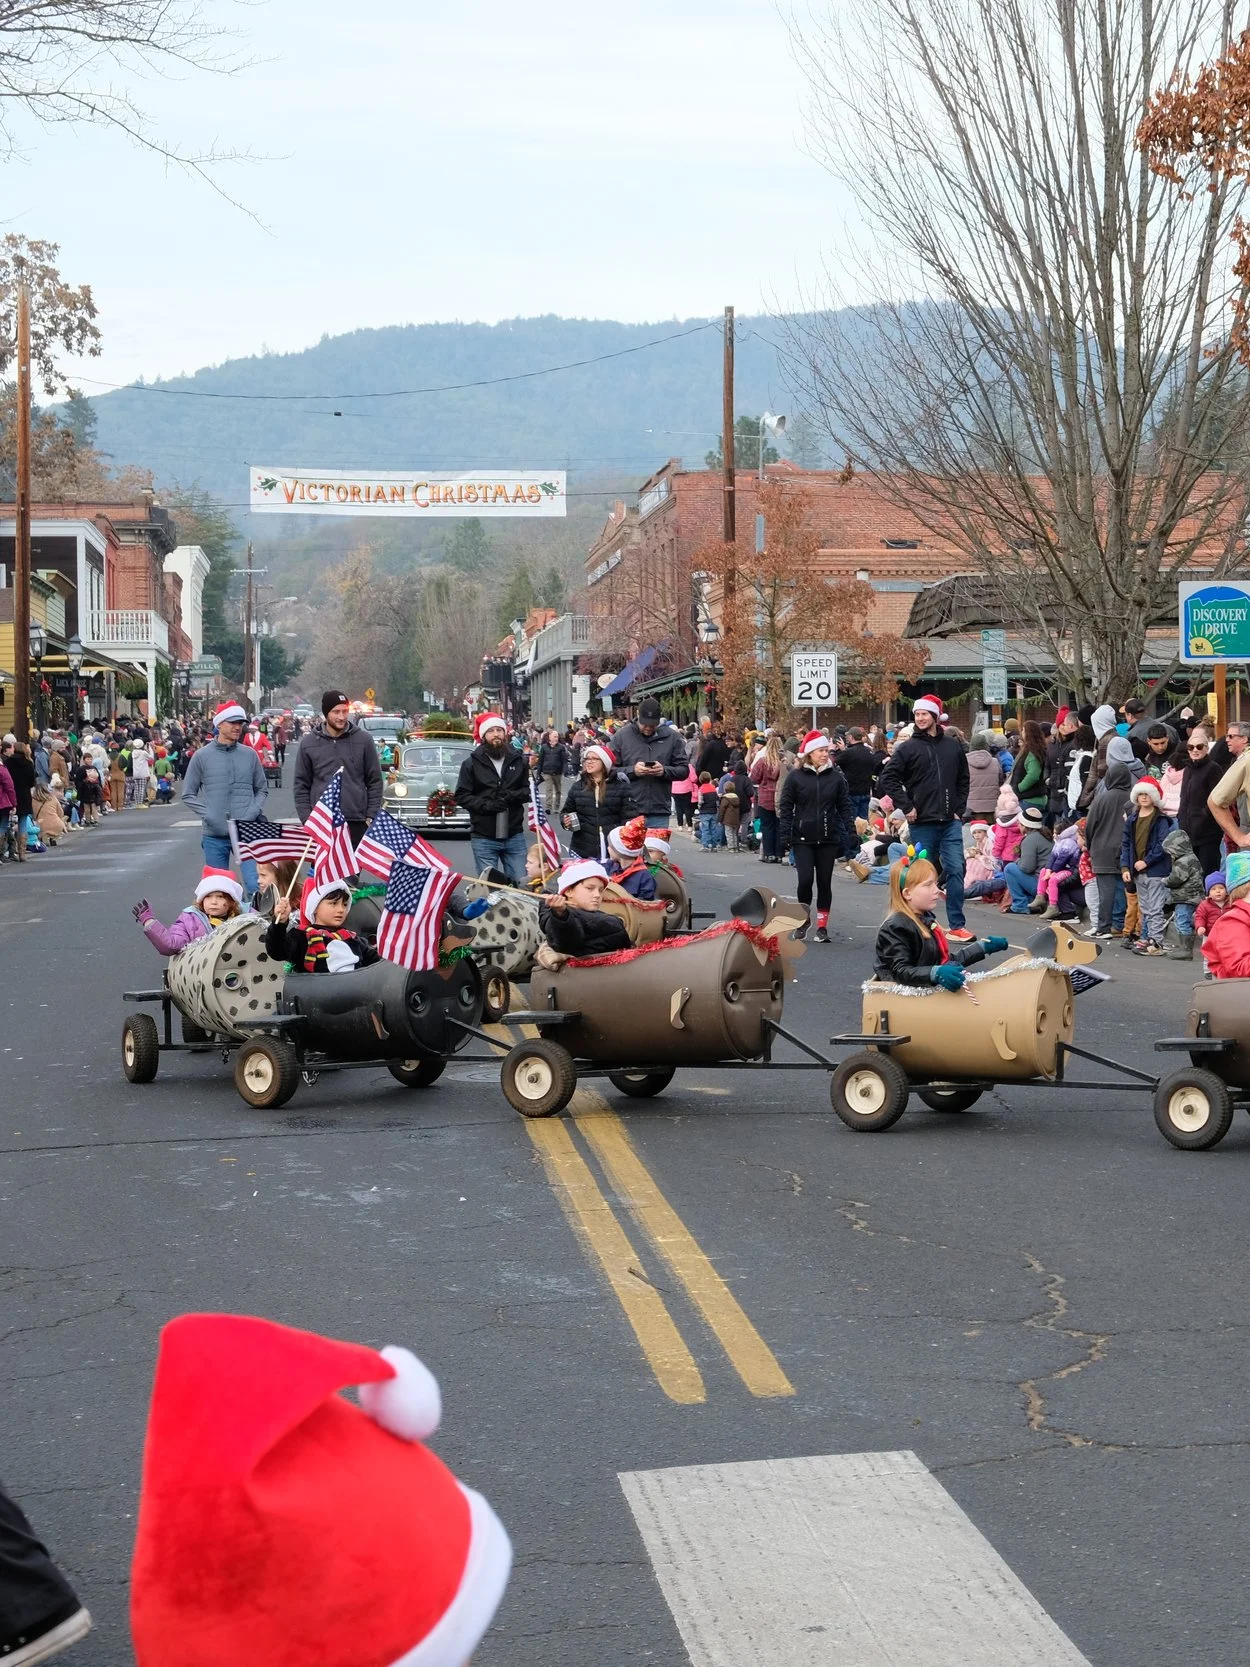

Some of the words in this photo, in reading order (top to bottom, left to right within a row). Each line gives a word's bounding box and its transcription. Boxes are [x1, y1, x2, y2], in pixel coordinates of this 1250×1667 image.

[279, 479, 405, 504] VICTORIAN
[411, 481, 541, 508] CHRISTMAS
[1192, 608, 1249, 622] DISCOVERY
[1204, 622, 1238, 635] DRIVE
[796, 658, 833, 667] SPEED
[800, 670, 829, 679] LIMIT
[797, 681, 832, 700] 20
